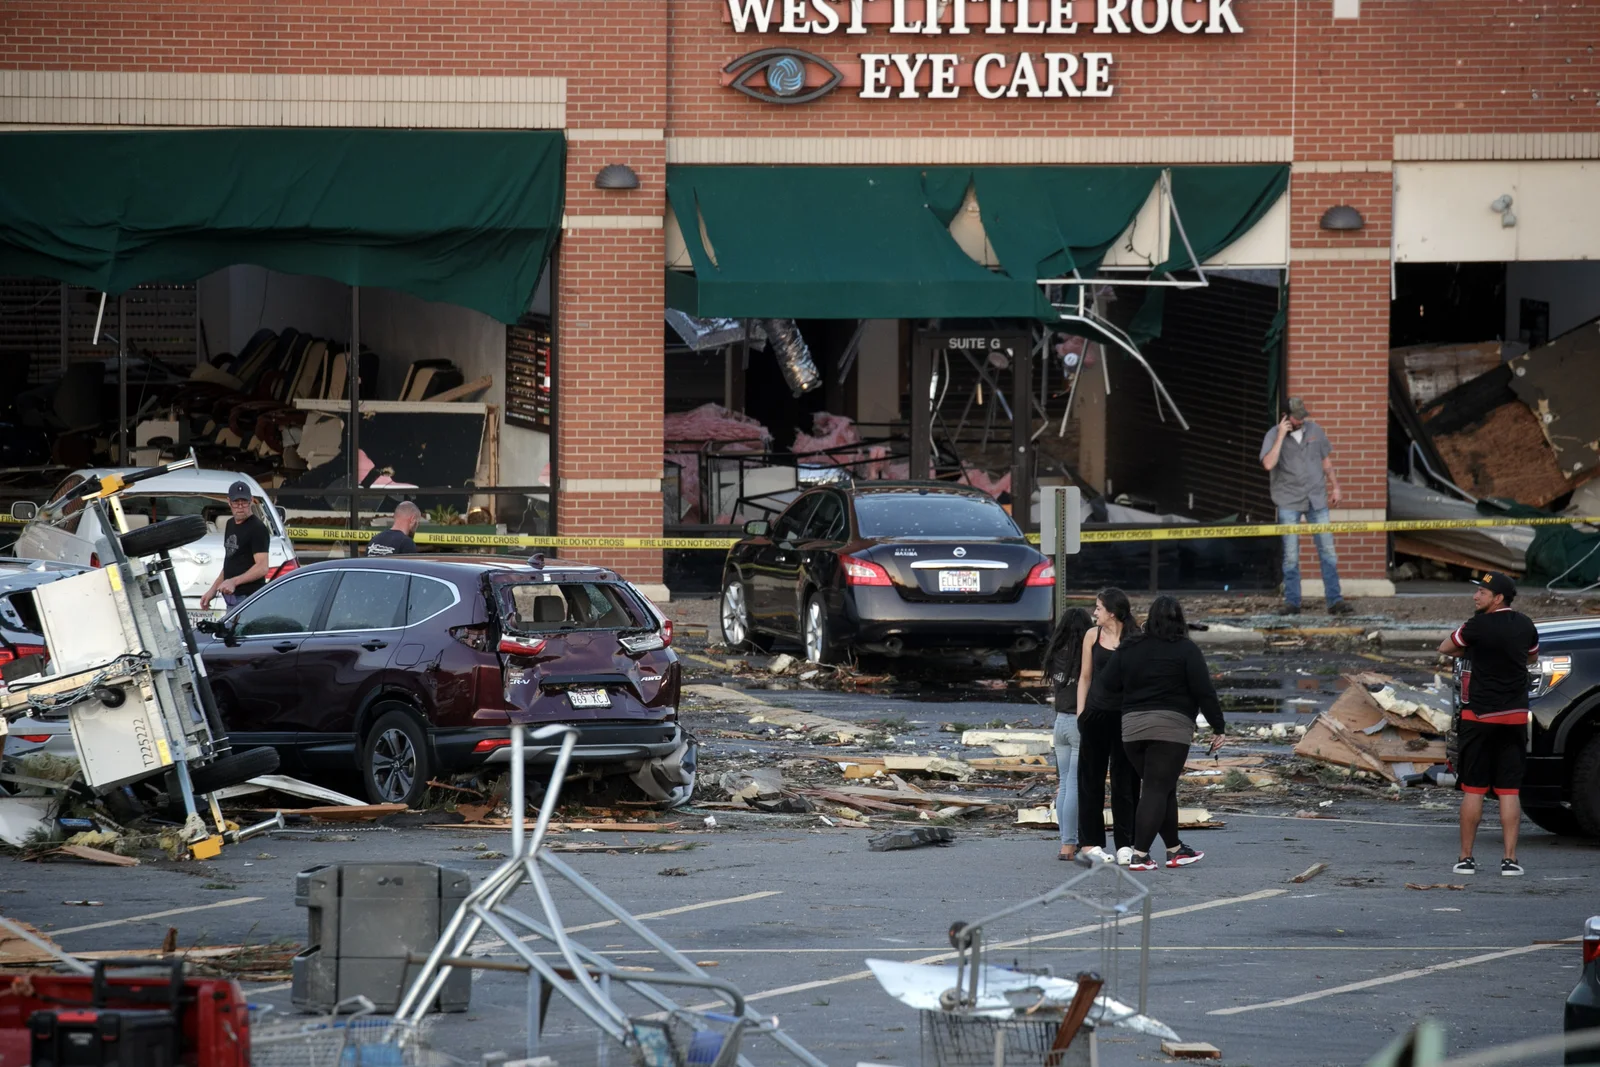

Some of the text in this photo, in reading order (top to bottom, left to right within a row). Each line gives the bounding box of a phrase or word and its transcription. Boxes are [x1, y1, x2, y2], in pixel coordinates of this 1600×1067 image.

[727, 0, 1245, 34] WEST LITTLE ROCK
[859, 52, 1114, 99] EYE CARE
[948, 338, 1000, 350] SUITE G
[1233, 527, 1260, 535] CROSS
[1341, 523, 1368, 532] CROSS
[341, 531, 356, 539] LINE
[494, 536, 520, 544] CROSS
[570, 696, 587, 704] 969
[133, 718, 154, 768] T225222
